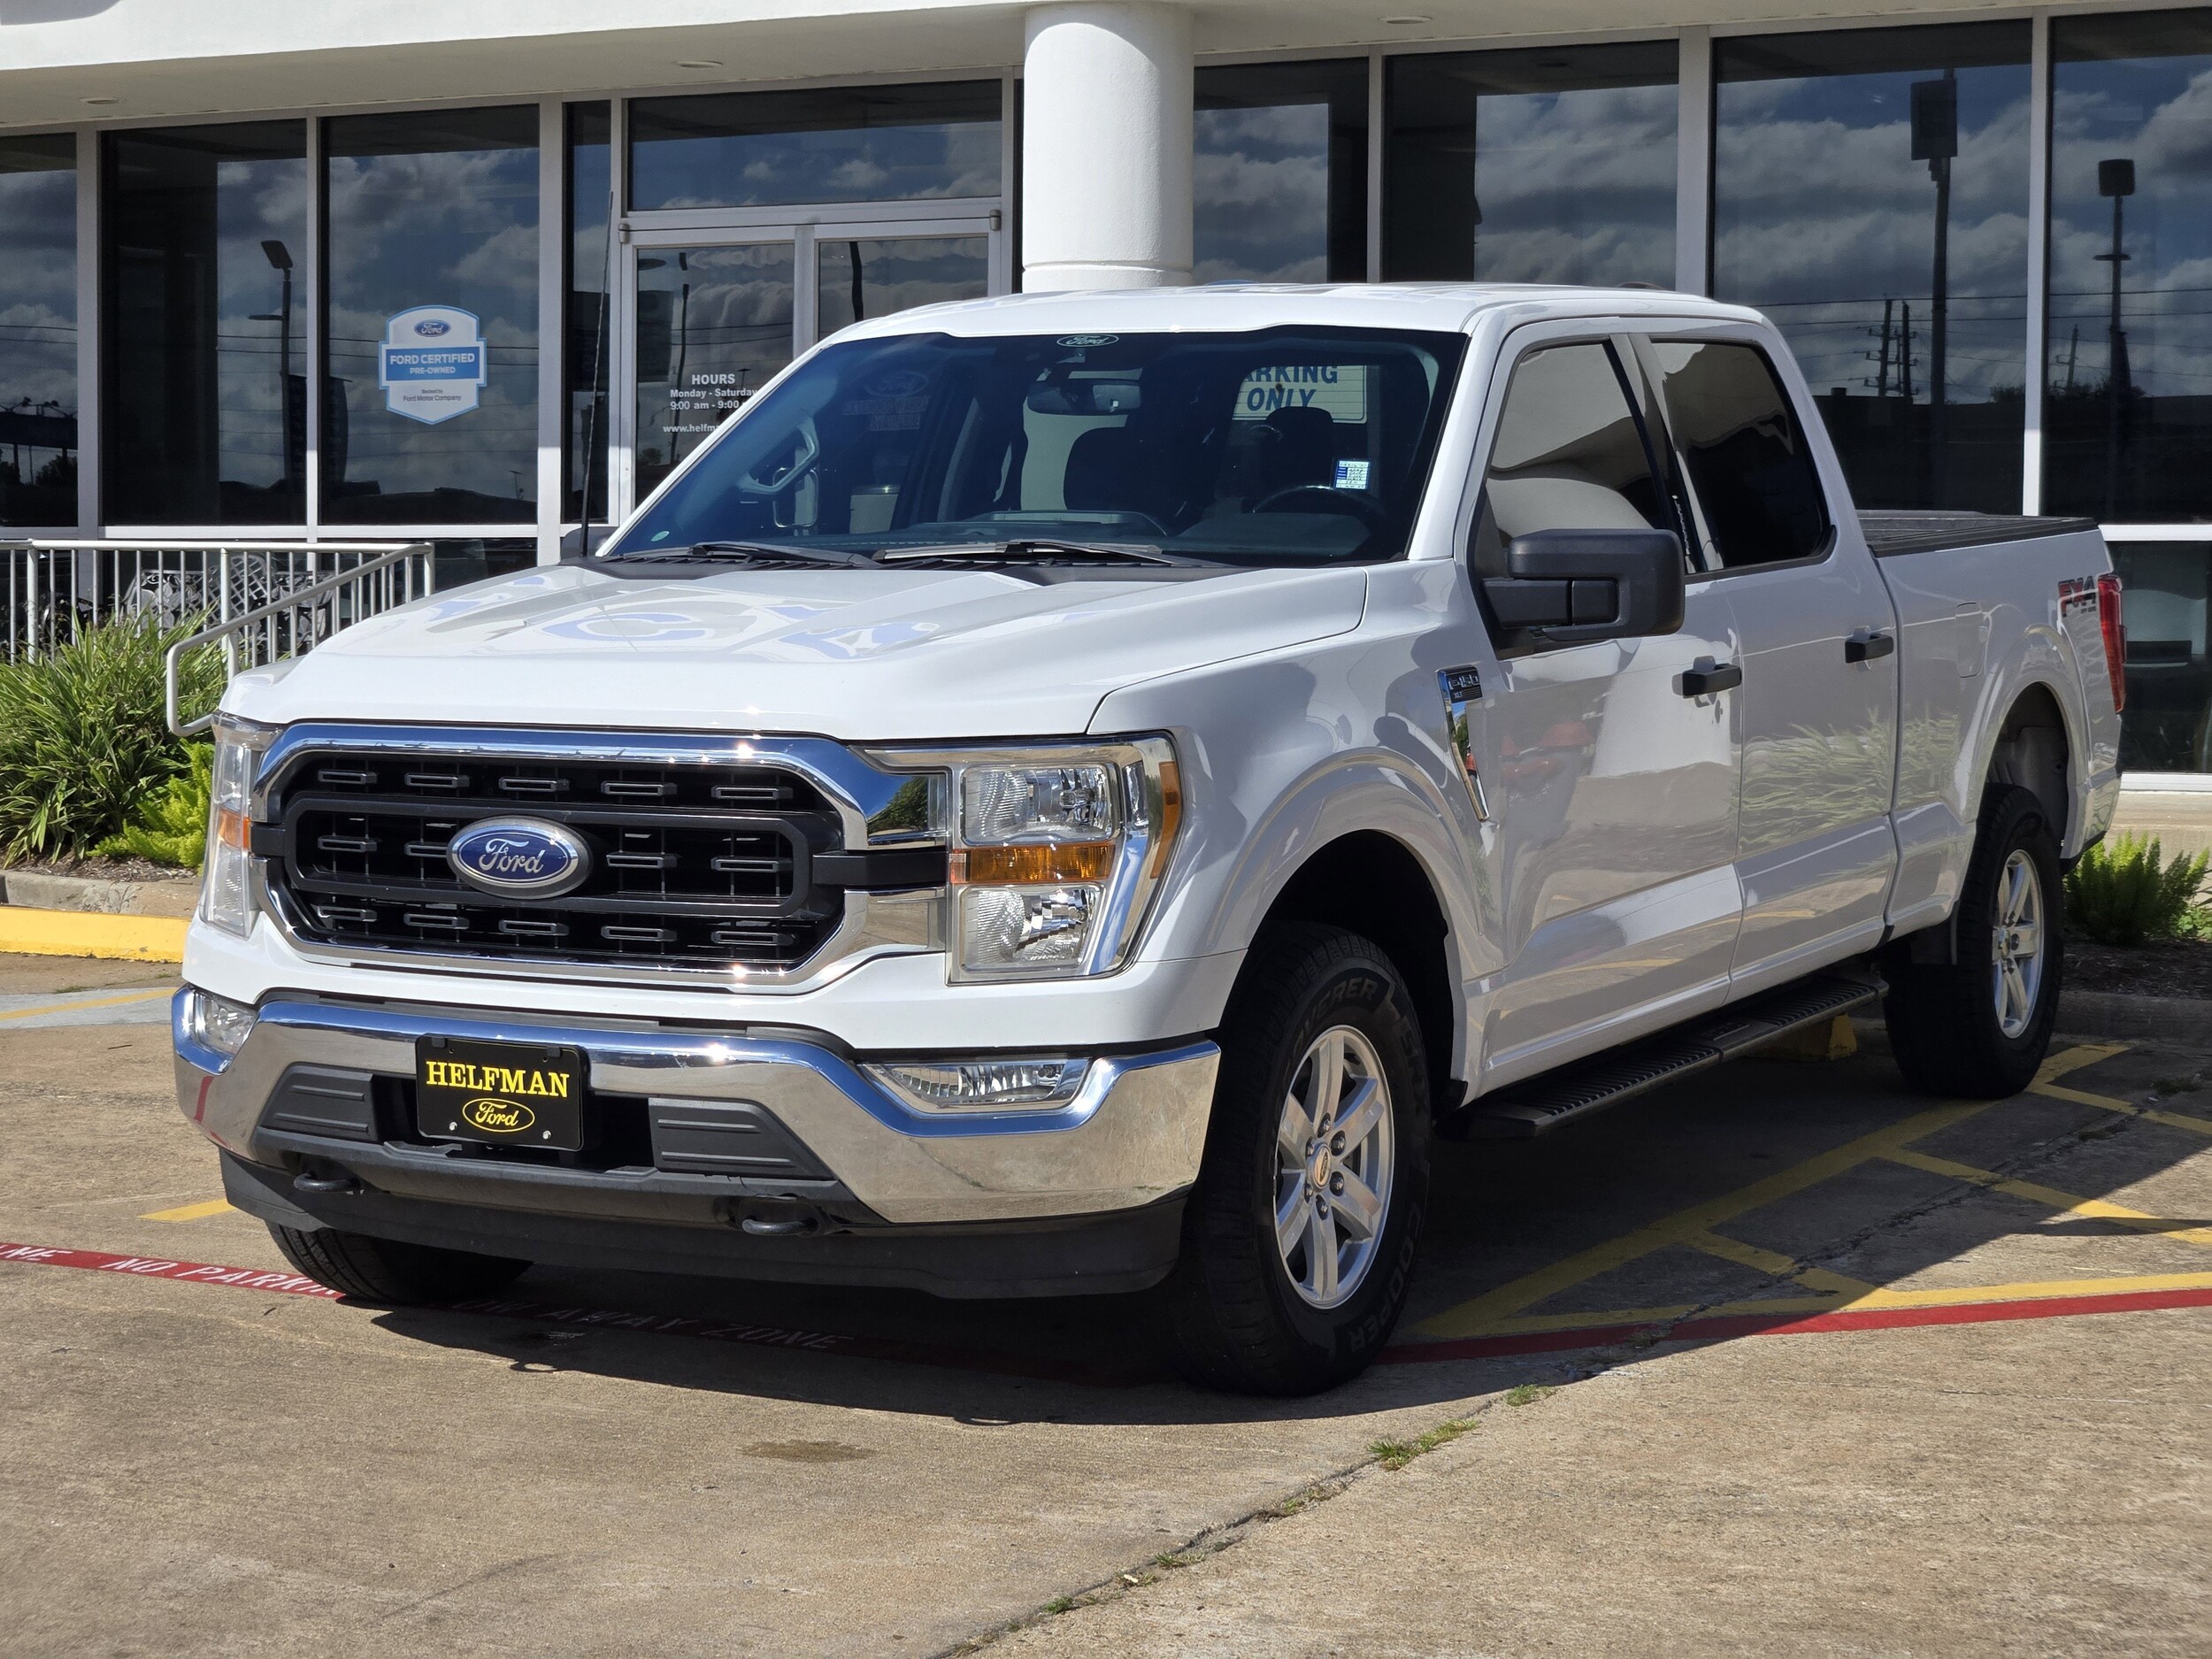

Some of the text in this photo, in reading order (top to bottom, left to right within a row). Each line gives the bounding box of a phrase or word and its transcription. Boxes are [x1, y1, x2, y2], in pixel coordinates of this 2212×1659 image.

[1065, 335, 1110, 345] Ford
[390, 353, 475, 365] FORD CERTIFIED
[691, 373, 735, 385] HOURS
[670, 389, 707, 399] Monday
[670, 401, 690, 410] 9:00
[718, 400, 740, 409] 9:00
[2058, 575, 2096, 618] FX4
[479, 838, 545, 874] Ford
[426, 1061, 570, 1098] HELFMAN
[475, 1101, 519, 1127] Ford
[99, 1257, 178, 1274] NO
[449, 1297, 541, 1315] OW
[536, 1308, 702, 1329] AWAY
[699, 1323, 856, 1348] ZONE
